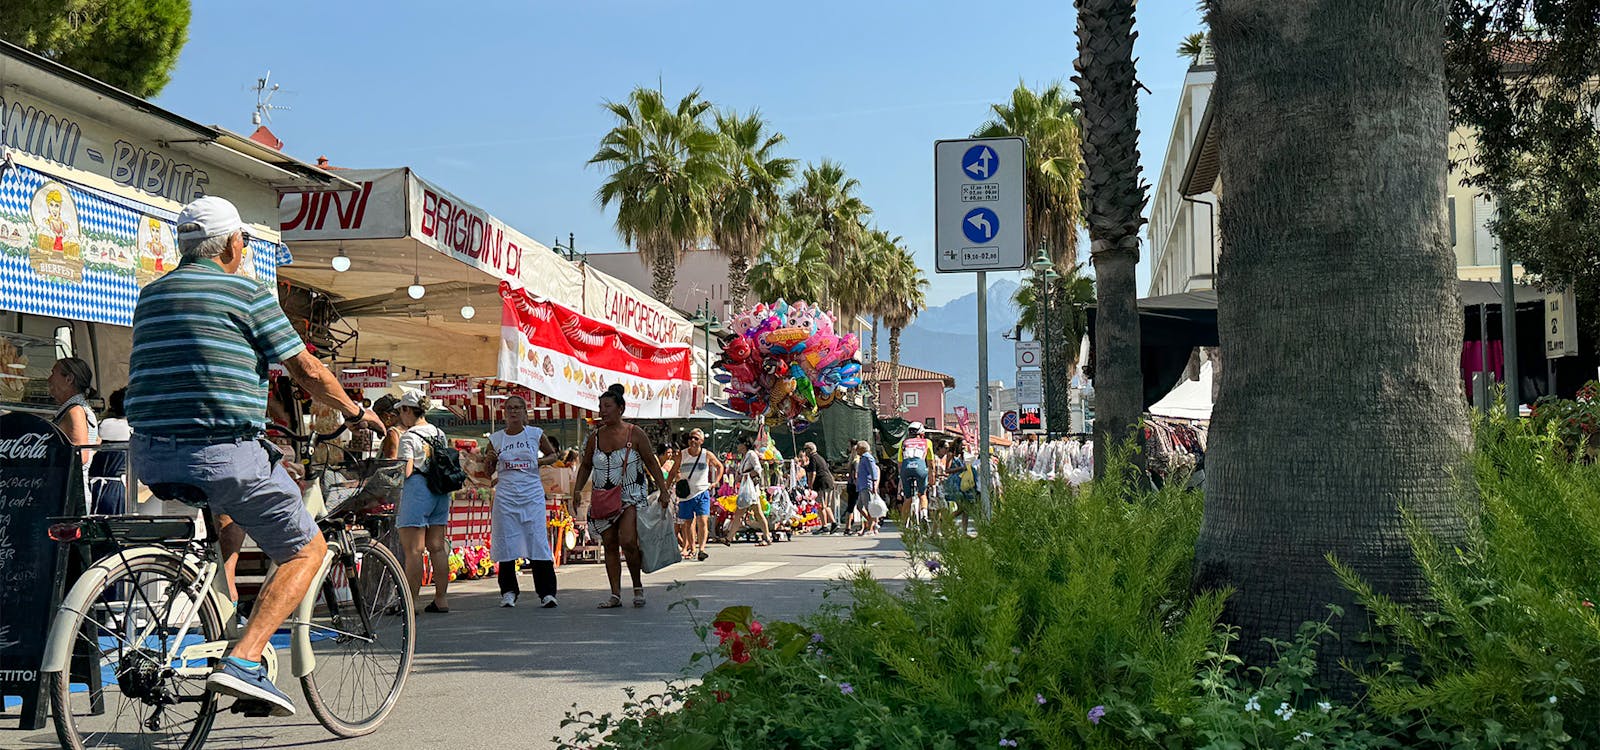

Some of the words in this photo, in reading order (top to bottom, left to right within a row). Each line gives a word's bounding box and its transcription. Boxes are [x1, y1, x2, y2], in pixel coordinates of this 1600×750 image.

[0, 96, 82, 169] NINI
[110, 139, 210, 206] BIBITE
[421, 188, 503, 270] BRIGIDINI
[505, 241, 523, 279] DI
